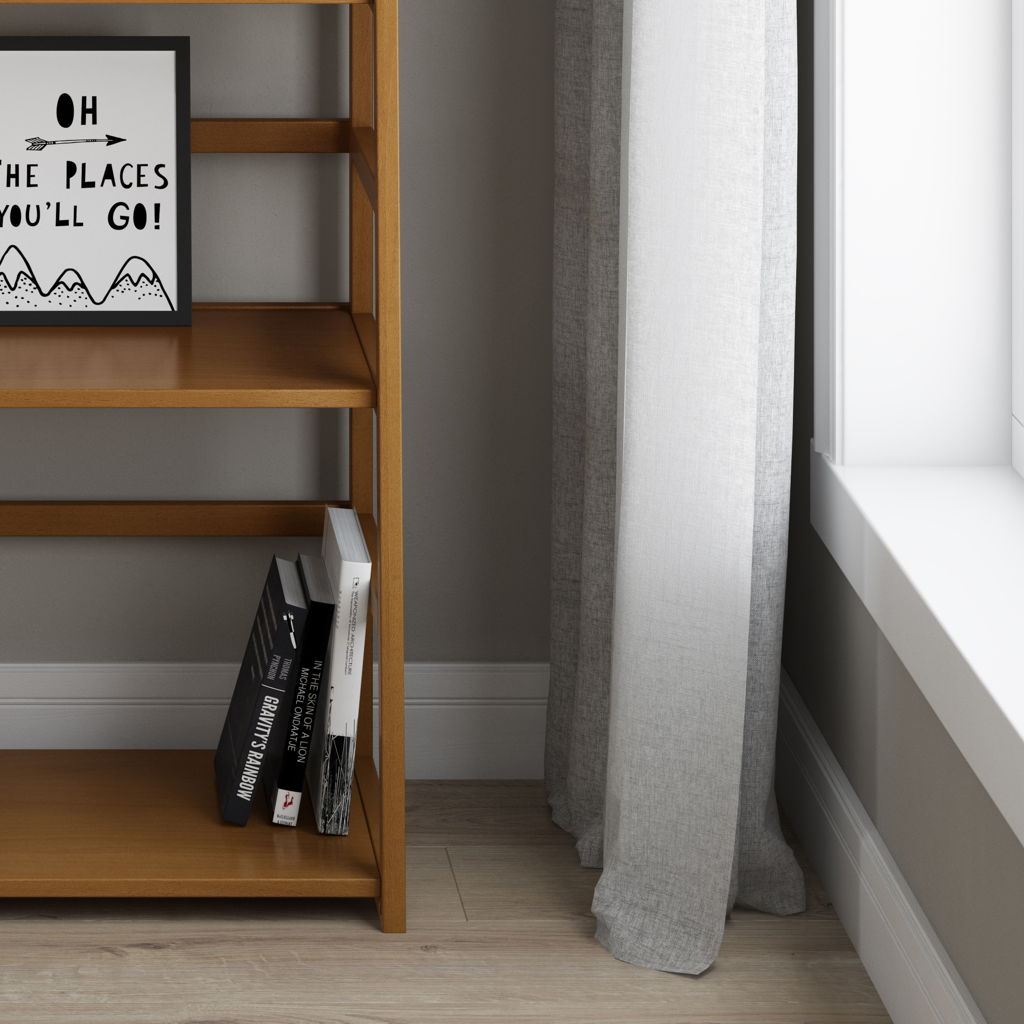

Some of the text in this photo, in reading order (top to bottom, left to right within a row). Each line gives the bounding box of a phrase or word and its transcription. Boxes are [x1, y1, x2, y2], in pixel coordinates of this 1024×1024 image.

[56, 93, 97, 128] OH
[66, 160, 169, 190] PLACES
[107, 201, 161, 230] GO!
[278, 658, 292, 680] THOMAS
[287, 667, 310, 752] MICHAEL ONDAATJE
[296, 660, 323, 764] IN THE SKIN OF A LION
[236, 696, 280, 801] GRAVITY'S RAINBOW
